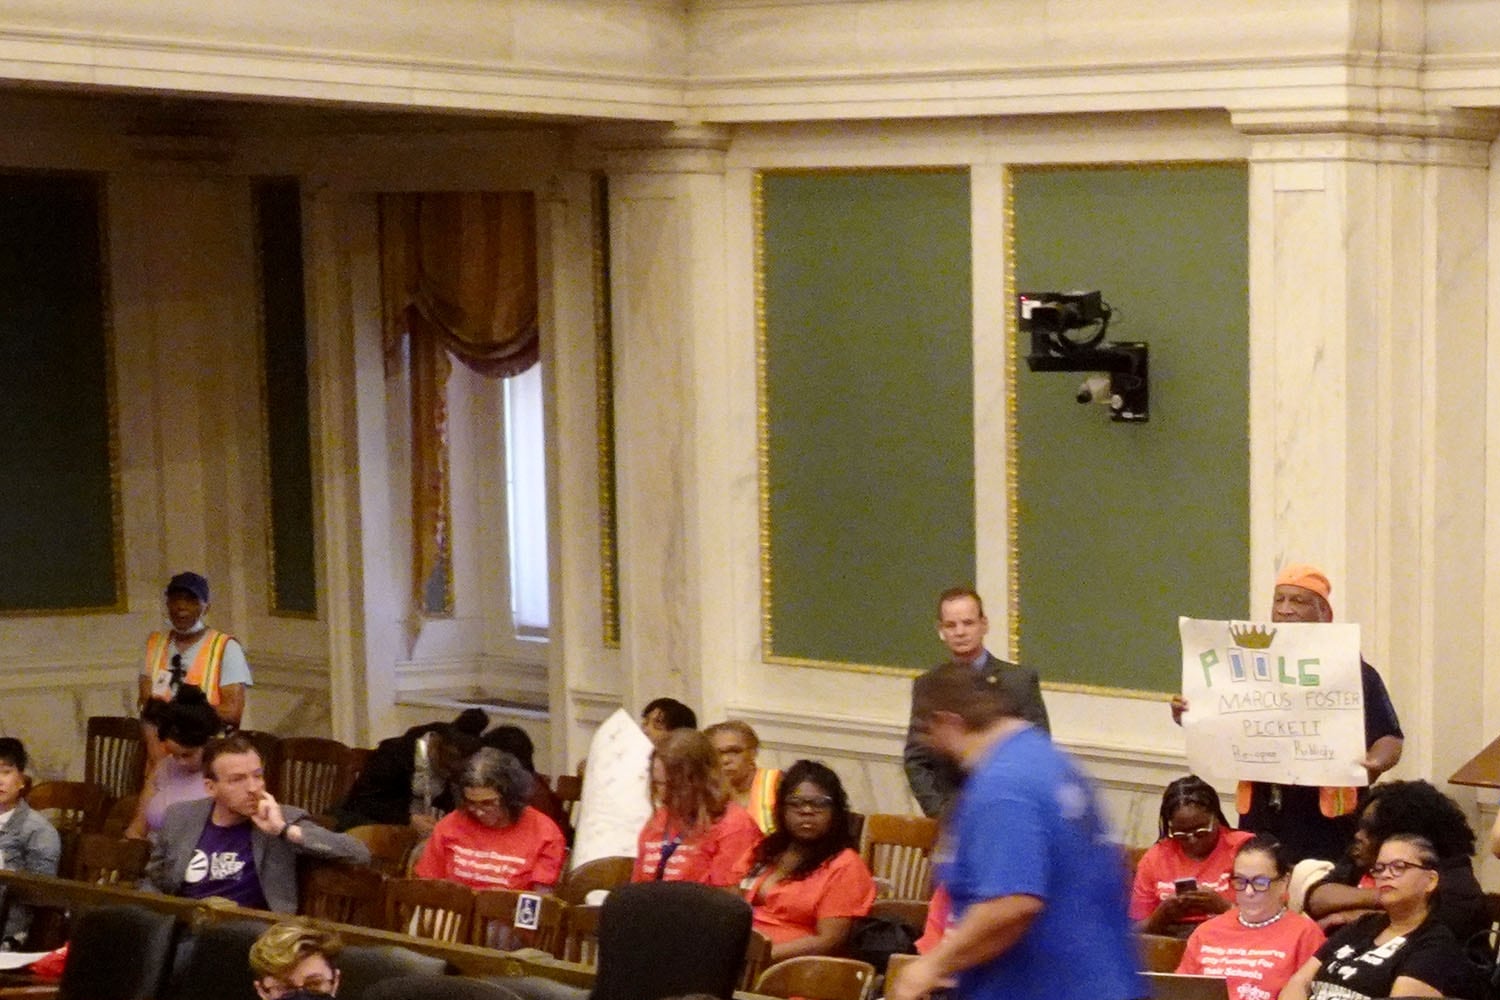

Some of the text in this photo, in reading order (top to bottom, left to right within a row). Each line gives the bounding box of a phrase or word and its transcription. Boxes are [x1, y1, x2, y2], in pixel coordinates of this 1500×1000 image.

[1218, 690, 1360, 713] MARCUS FOSTER
[1242, 719, 1321, 736] PICKETT
